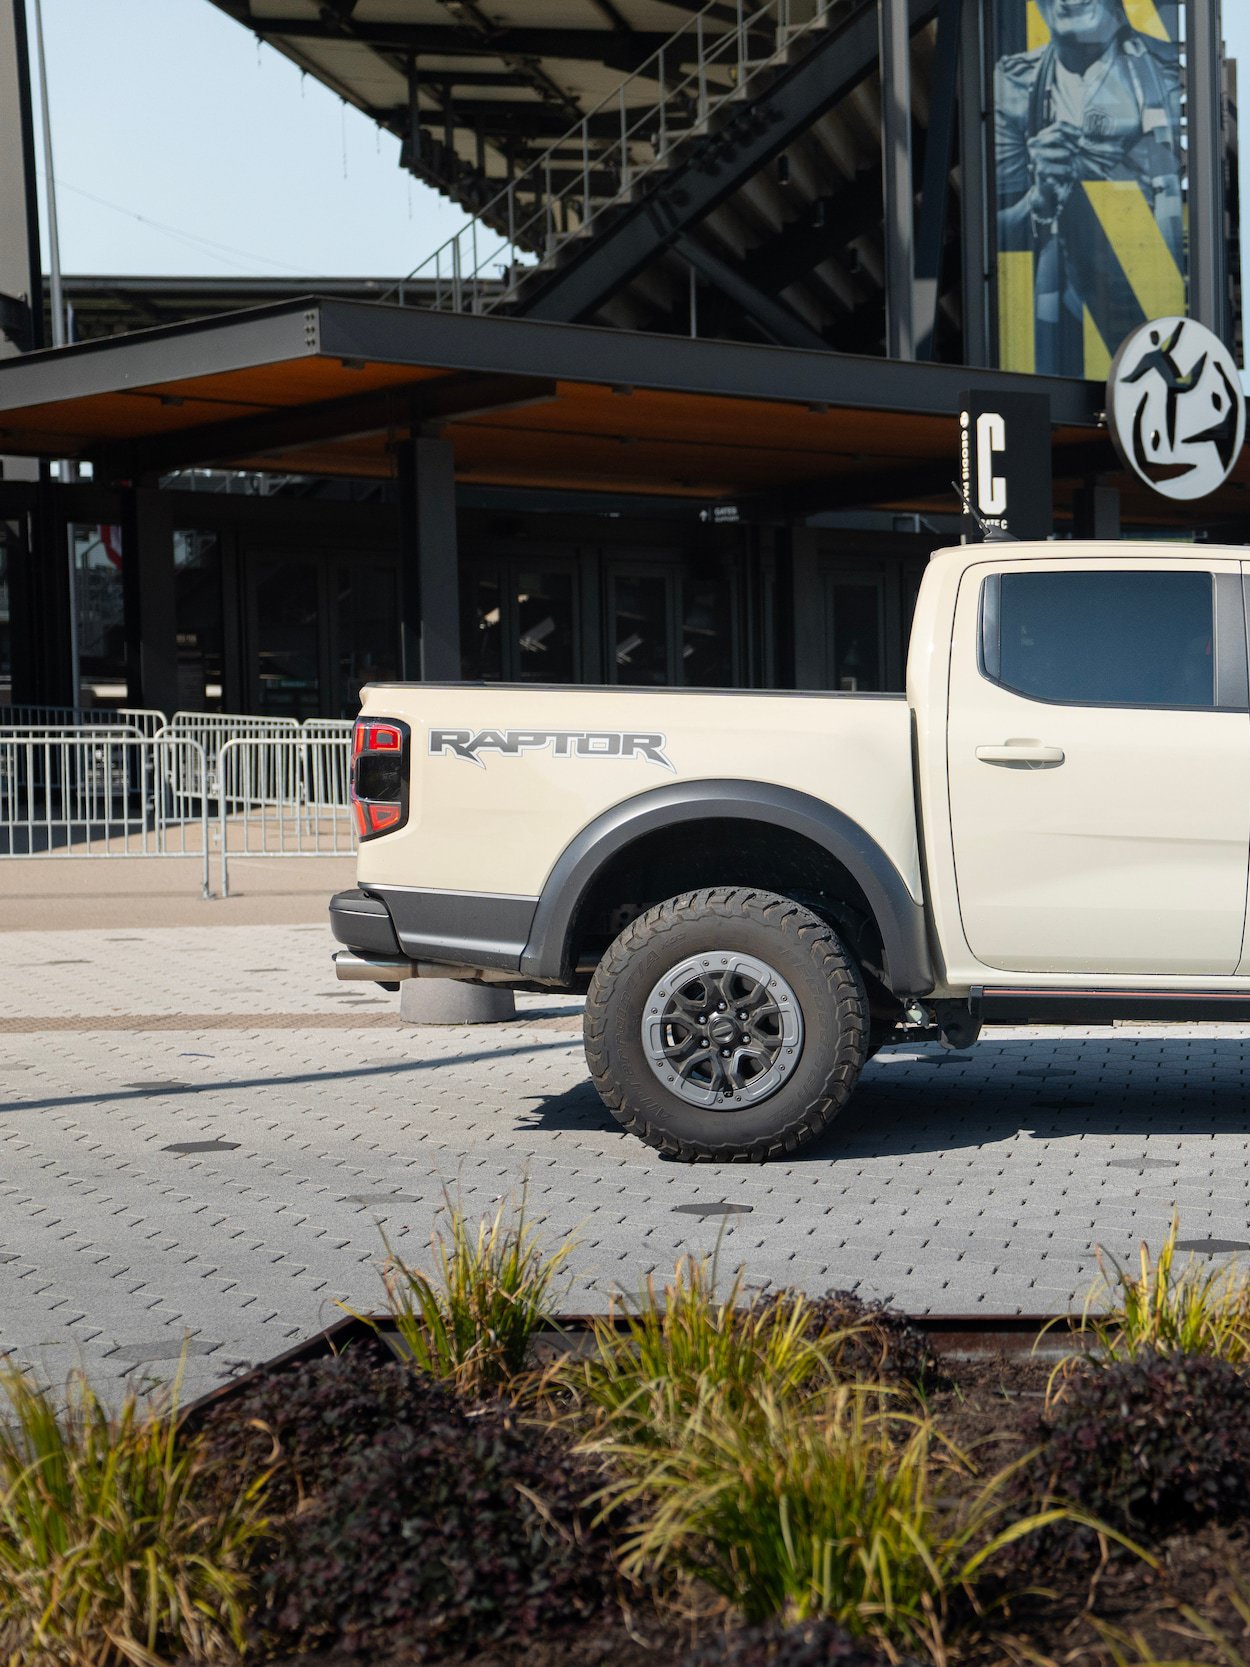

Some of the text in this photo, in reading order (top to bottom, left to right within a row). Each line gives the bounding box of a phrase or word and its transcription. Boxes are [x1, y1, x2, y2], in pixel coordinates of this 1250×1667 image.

[976, 412, 1007, 516] C
[1000, 519, 1008, 530] C
[429, 728, 678, 775] RAPTOR
